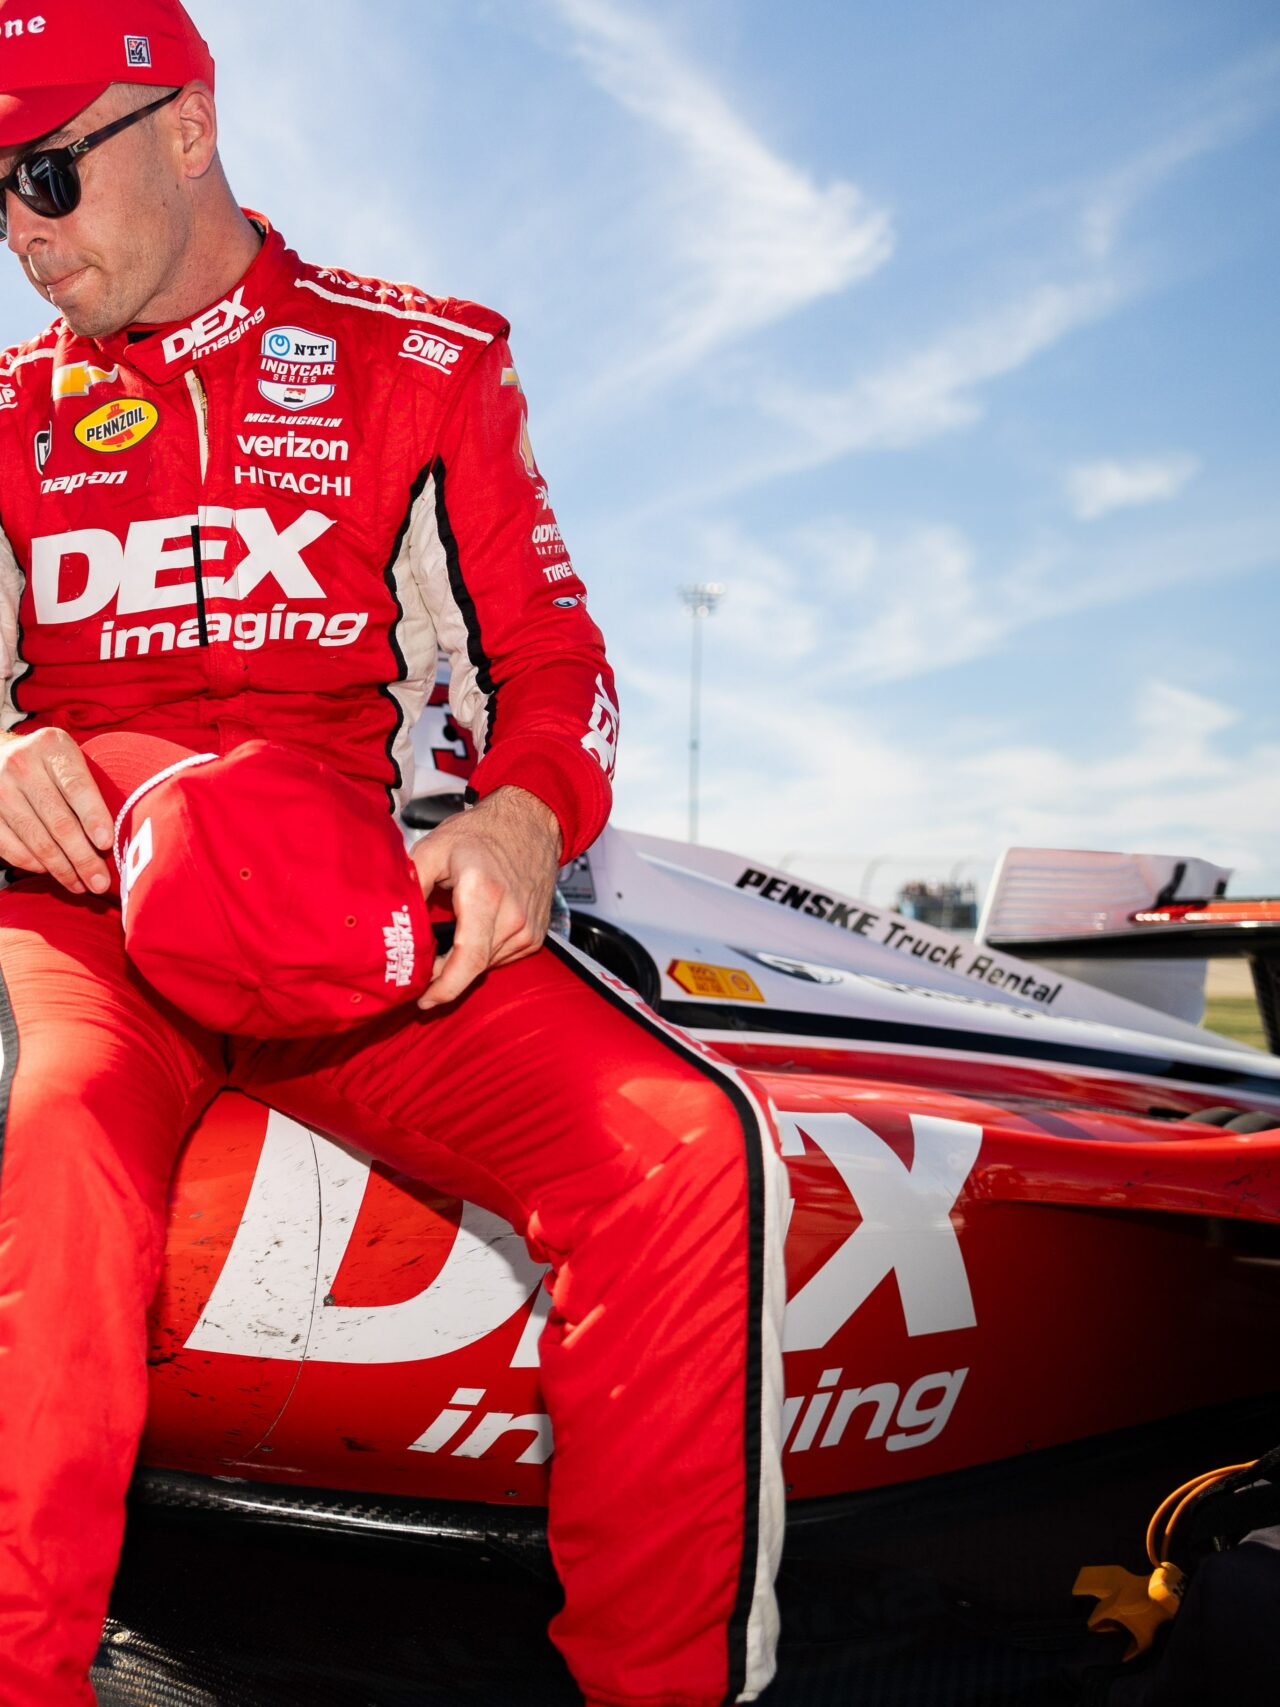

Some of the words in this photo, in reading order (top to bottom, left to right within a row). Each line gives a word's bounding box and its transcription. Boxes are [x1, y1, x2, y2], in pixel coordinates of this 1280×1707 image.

[161, 285, 250, 364] DEX
[192, 306, 266, 361] imaging
[294, 343, 329, 356] NTT
[402, 334, 460, 366] OMP
[260, 357, 336, 377] INDYCAR
[272, 373, 318, 384] SERIES
[86, 406, 146, 442] PENNZOIL
[243, 412, 343, 428] MCLAUGHLIN
[236, 430, 349, 461] verizon
[40, 470, 128, 495] nap-on
[234, 465, 351, 497] HITACHI
[31, 505, 338, 625] DEX
[542, 560, 575, 584] TIRE
[99, 603, 369, 661] imaging
[735, 867, 880, 936] PENSKE
[882, 921, 965, 970] Truck
[966, 953, 1063, 1006] Rental
[382, 926, 400, 984] TEAM
